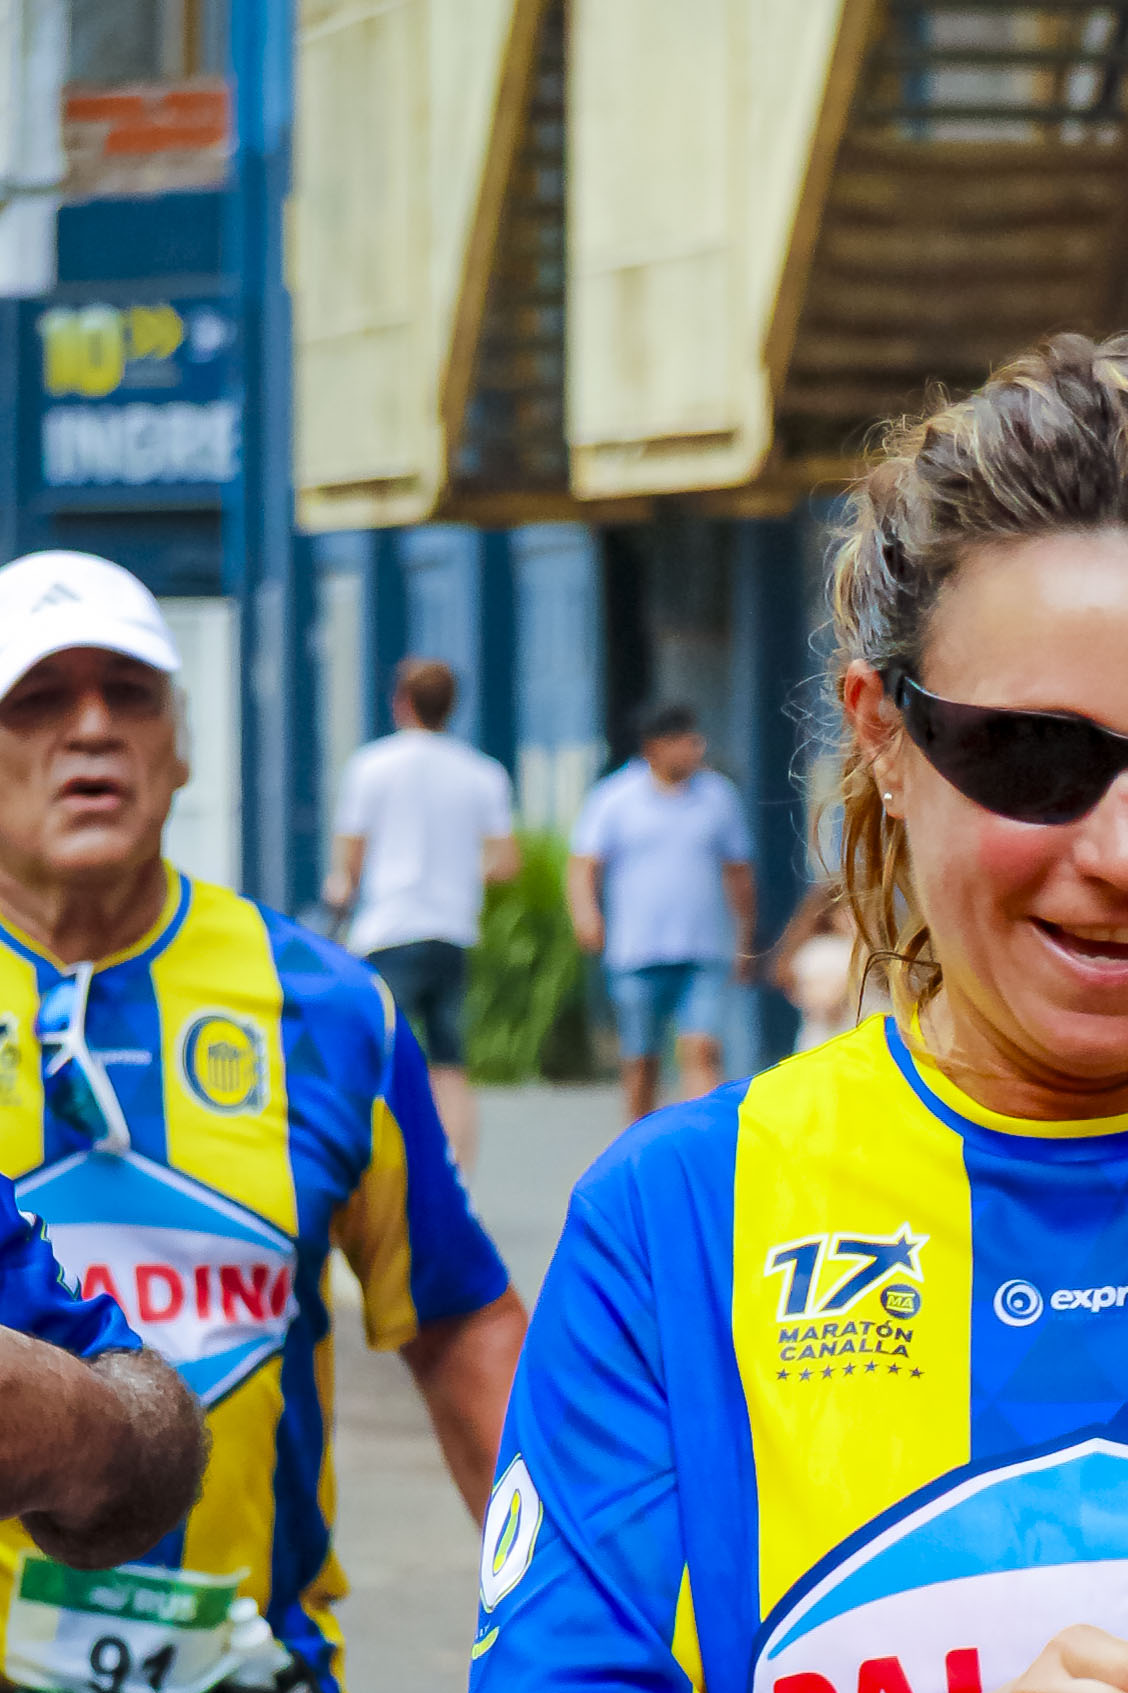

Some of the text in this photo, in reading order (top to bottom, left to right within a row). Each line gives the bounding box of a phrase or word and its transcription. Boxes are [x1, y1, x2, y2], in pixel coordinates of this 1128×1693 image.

[765, 1226, 930, 1322] 17
[778, 1320, 914, 1343] MARATÓN
[780, 1339, 909, 1361] CANALLA
